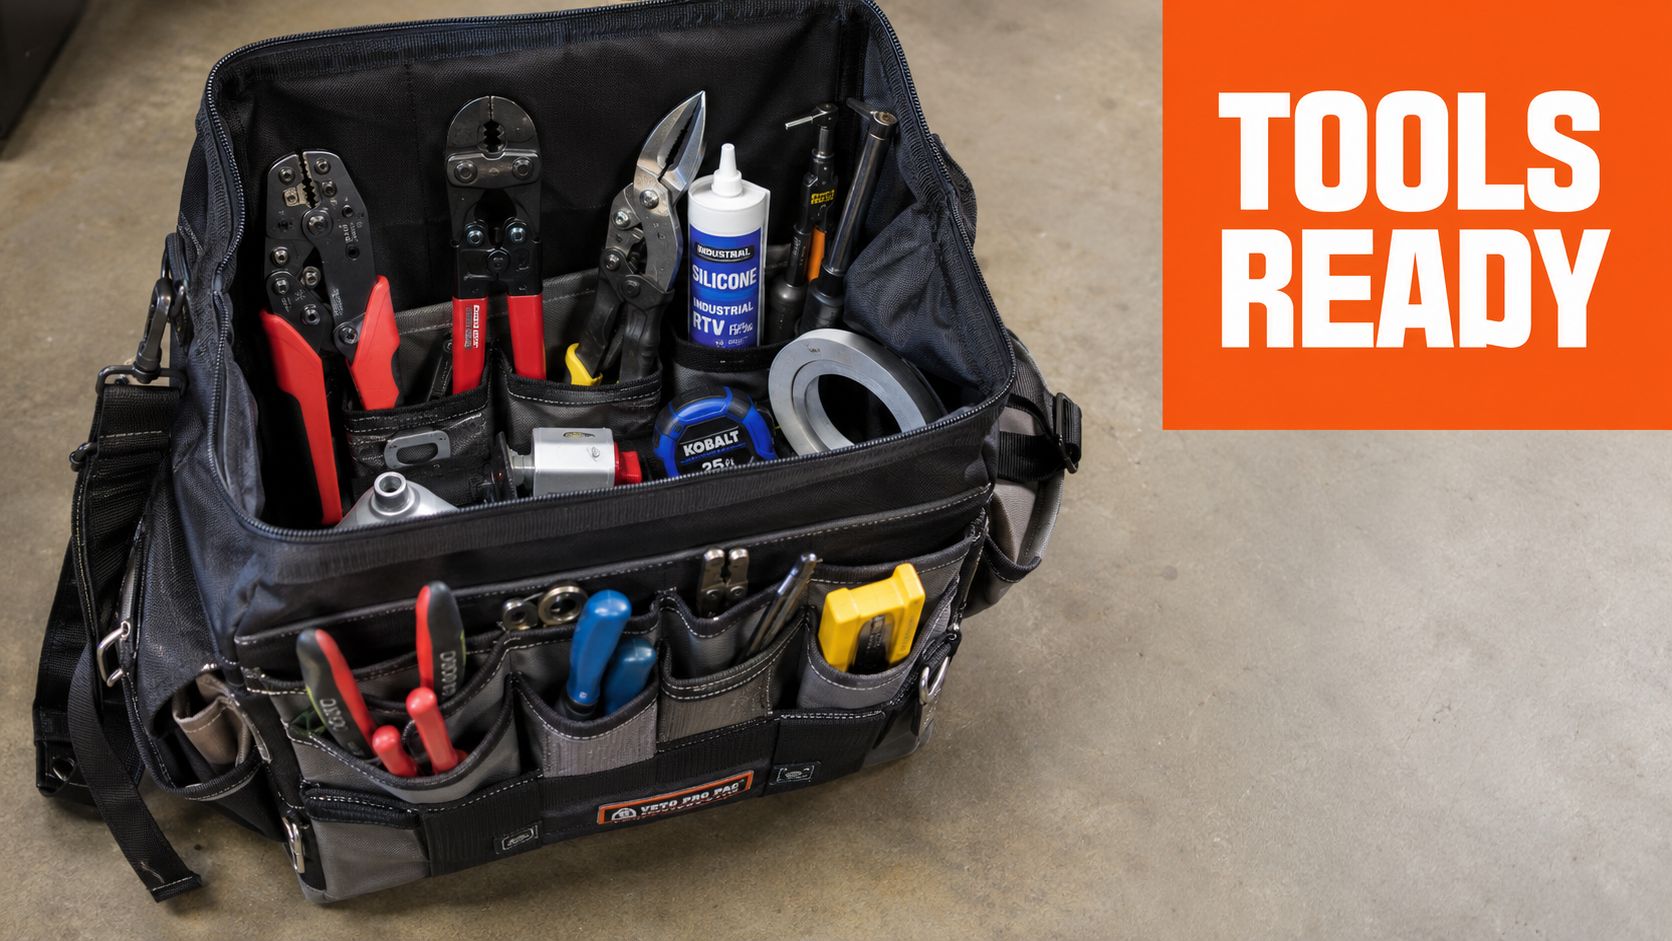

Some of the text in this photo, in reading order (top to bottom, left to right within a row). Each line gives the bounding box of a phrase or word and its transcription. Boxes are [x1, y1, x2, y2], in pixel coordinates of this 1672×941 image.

[692, 264, 757, 290] SILICONE
[693, 296, 754, 316] INDUSTRIAL
[693, 310, 725, 336] RTV
[683, 431, 739, 457] KOBALT
[701, 458, 725, 473] 25
[640, 800, 678, 813] VETO
[682, 791, 710, 805] PRO
